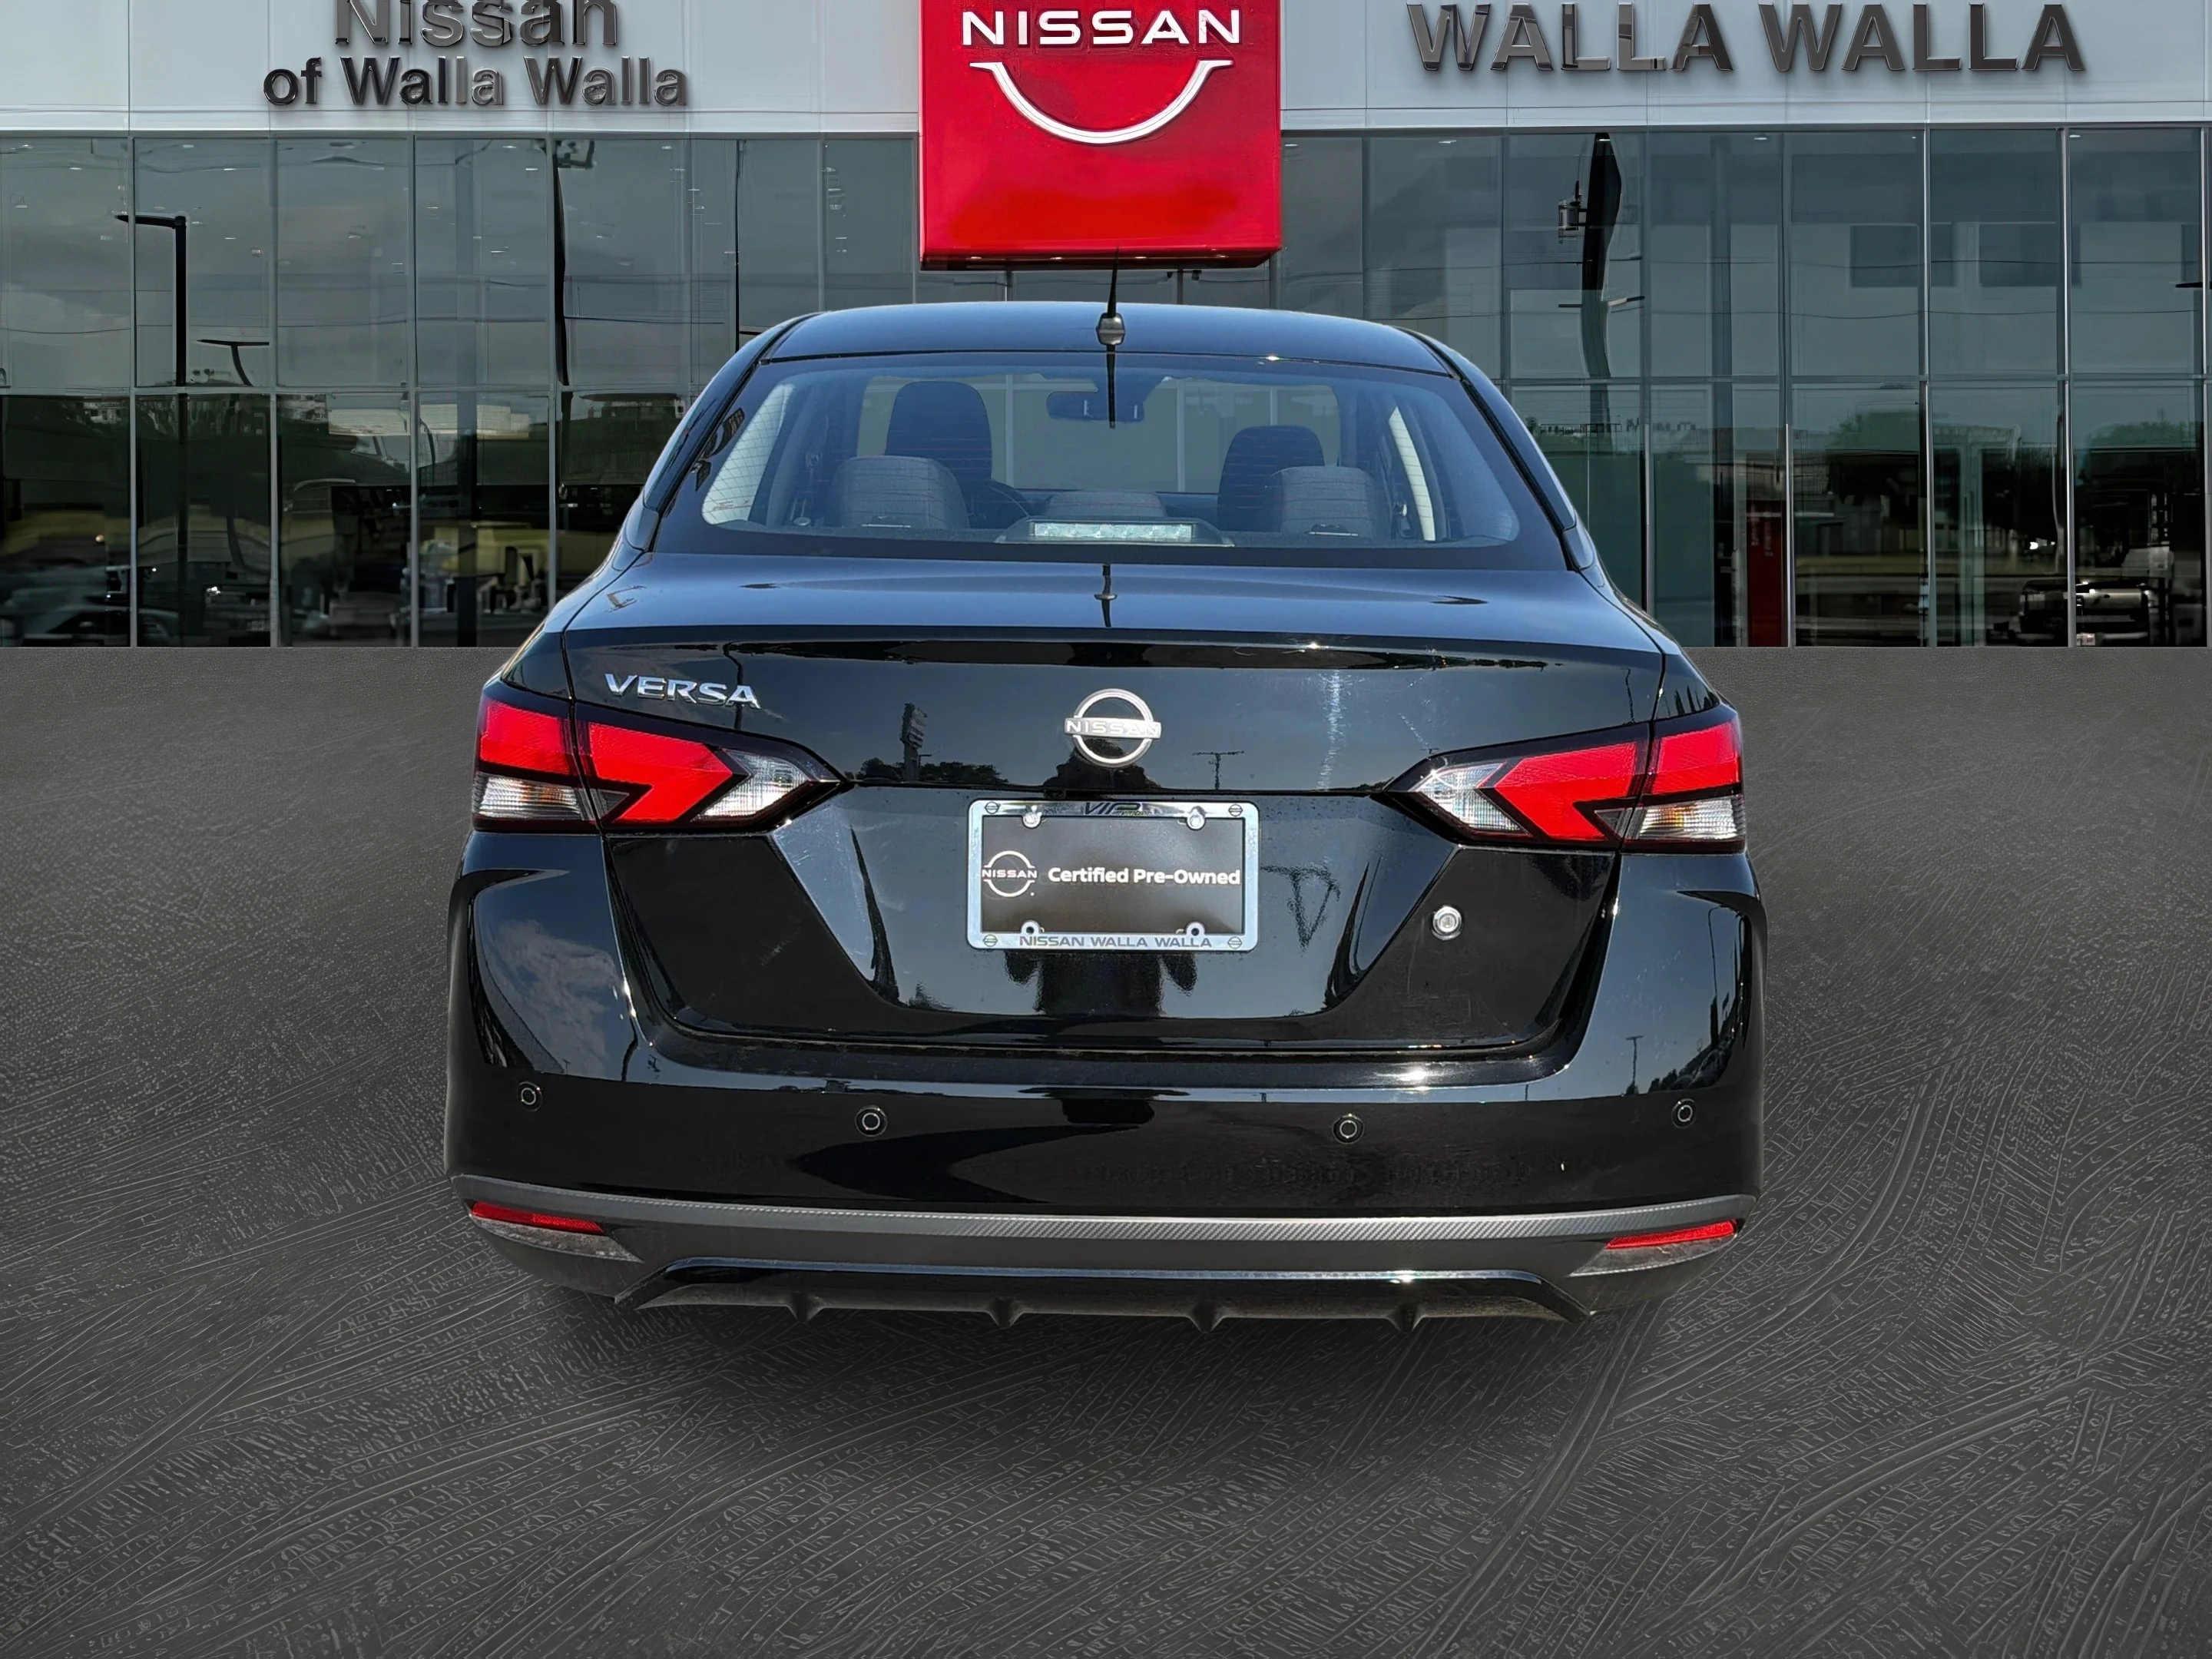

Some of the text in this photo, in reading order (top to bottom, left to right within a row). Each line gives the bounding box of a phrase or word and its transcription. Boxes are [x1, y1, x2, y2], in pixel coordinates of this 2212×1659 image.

[334, 0, 618, 47] Nissan
[962, 10, 1241, 46] NISSAN
[1406, 3, 2085, 71] WALLA WALLA
[263, 55, 688, 106] of Walla Walla
[604, 673, 762, 710] VERSA
[1066, 720, 1161, 737] NISSAN
[1084, 802, 1141, 815] VIP
[982, 869, 1038, 879] NISSAN
[1048, 866, 1241, 885] Certified Pre-Owned
[1019, 935, 1213, 948] NISSAN WALLA WALLA
